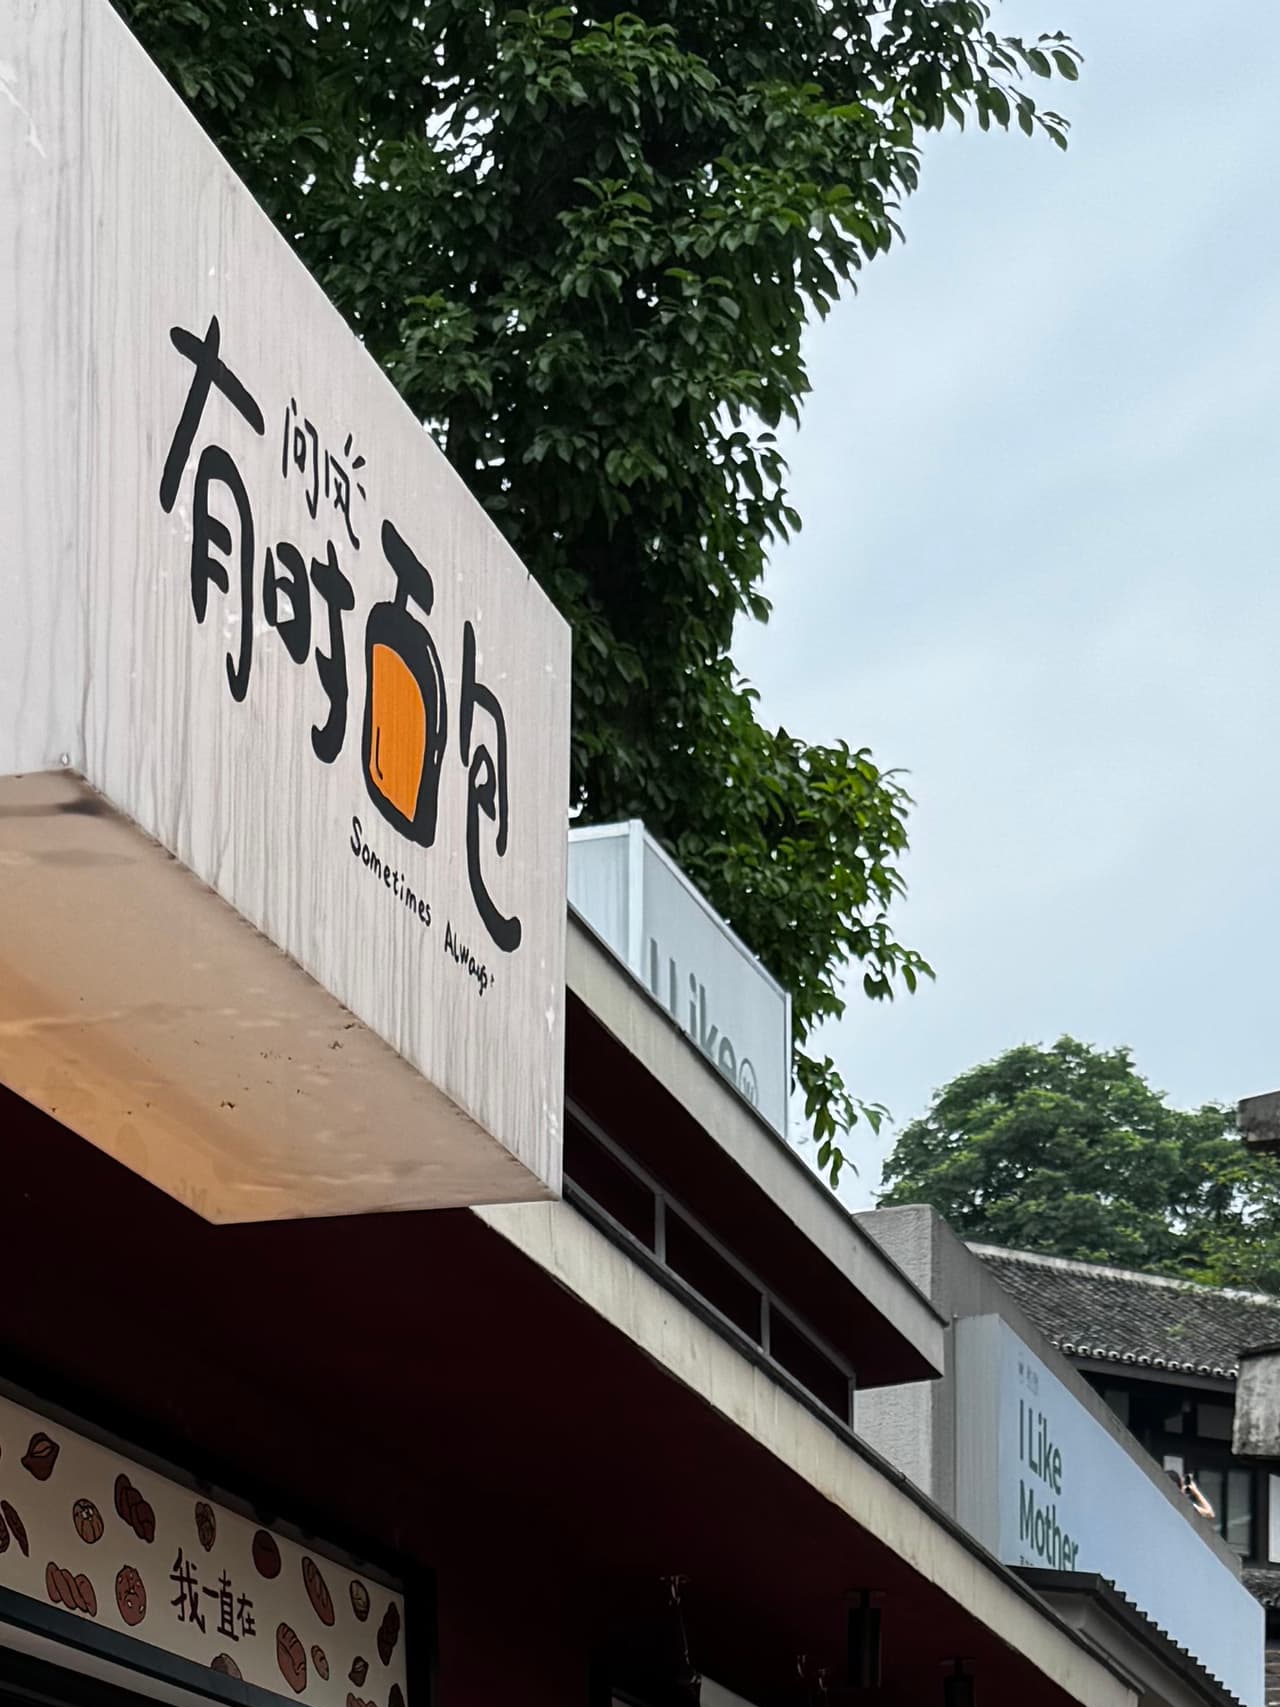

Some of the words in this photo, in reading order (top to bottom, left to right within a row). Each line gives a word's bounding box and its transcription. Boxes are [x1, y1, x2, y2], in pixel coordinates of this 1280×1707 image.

[351, 815, 432, 927] Sometimes
[1019, 1399, 1025, 1461] I
[1028, 1407, 1063, 1496] Like
[1020, 1479, 1080, 1573] Mother
[169, 1547, 257, 1641] 我一直在
